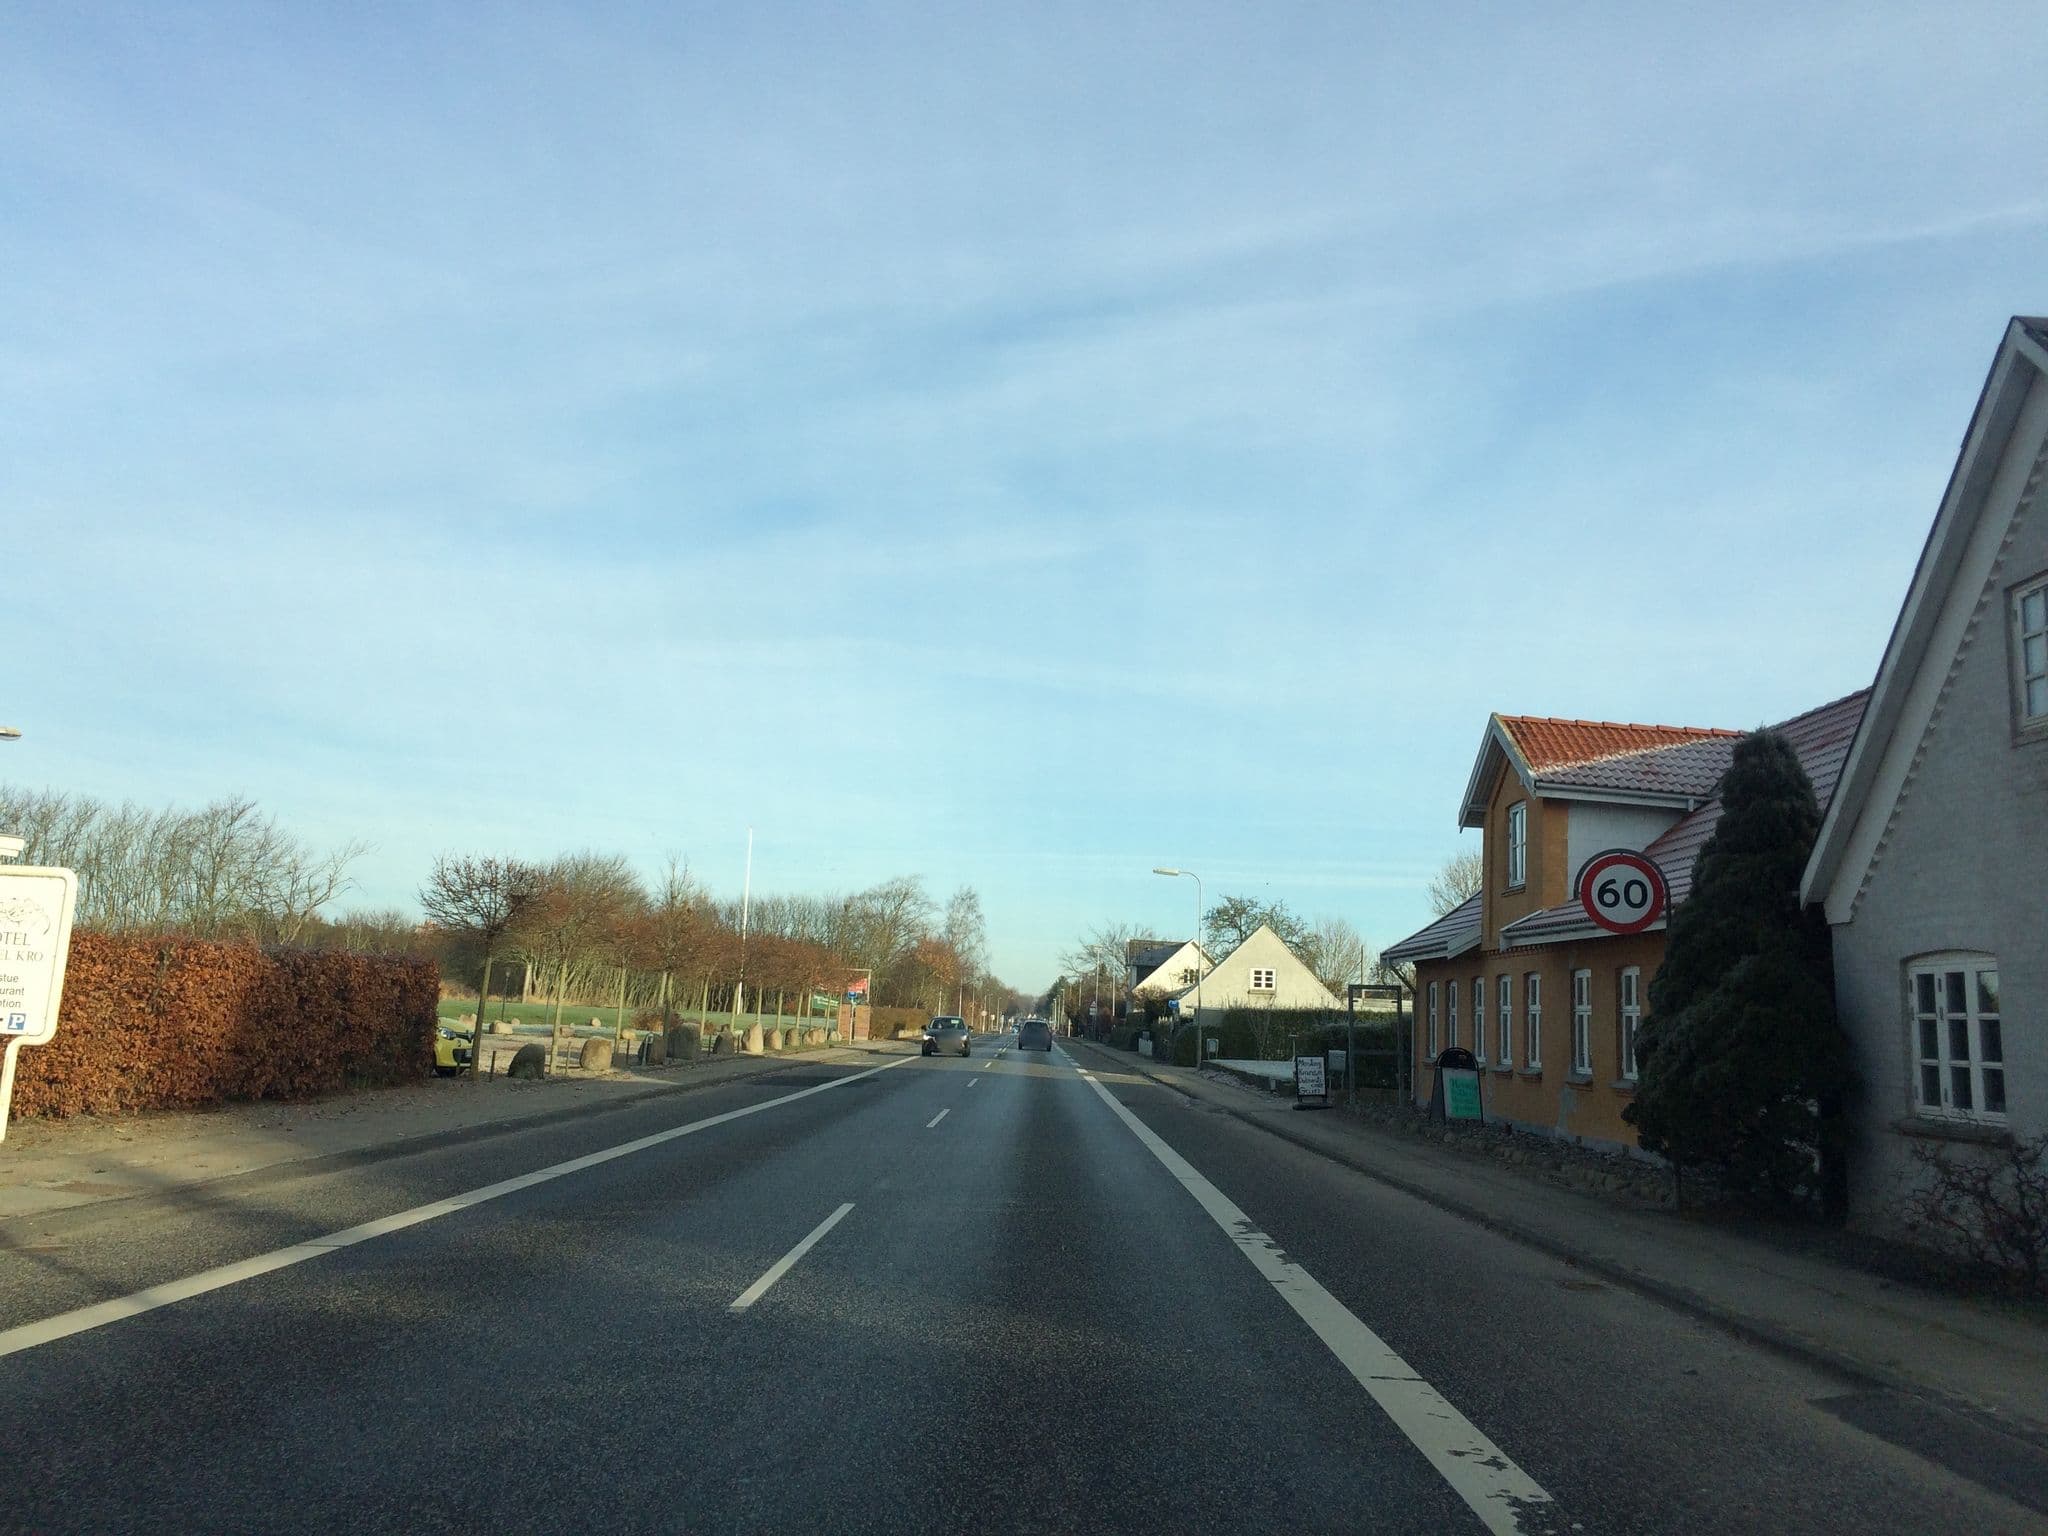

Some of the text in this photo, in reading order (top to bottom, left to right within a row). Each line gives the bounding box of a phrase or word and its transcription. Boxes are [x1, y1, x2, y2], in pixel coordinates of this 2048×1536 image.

[1597, 878, 1648, 909] 60
[0, 931, 31, 945] TEL
[16, 949, 43, 961] KRO
